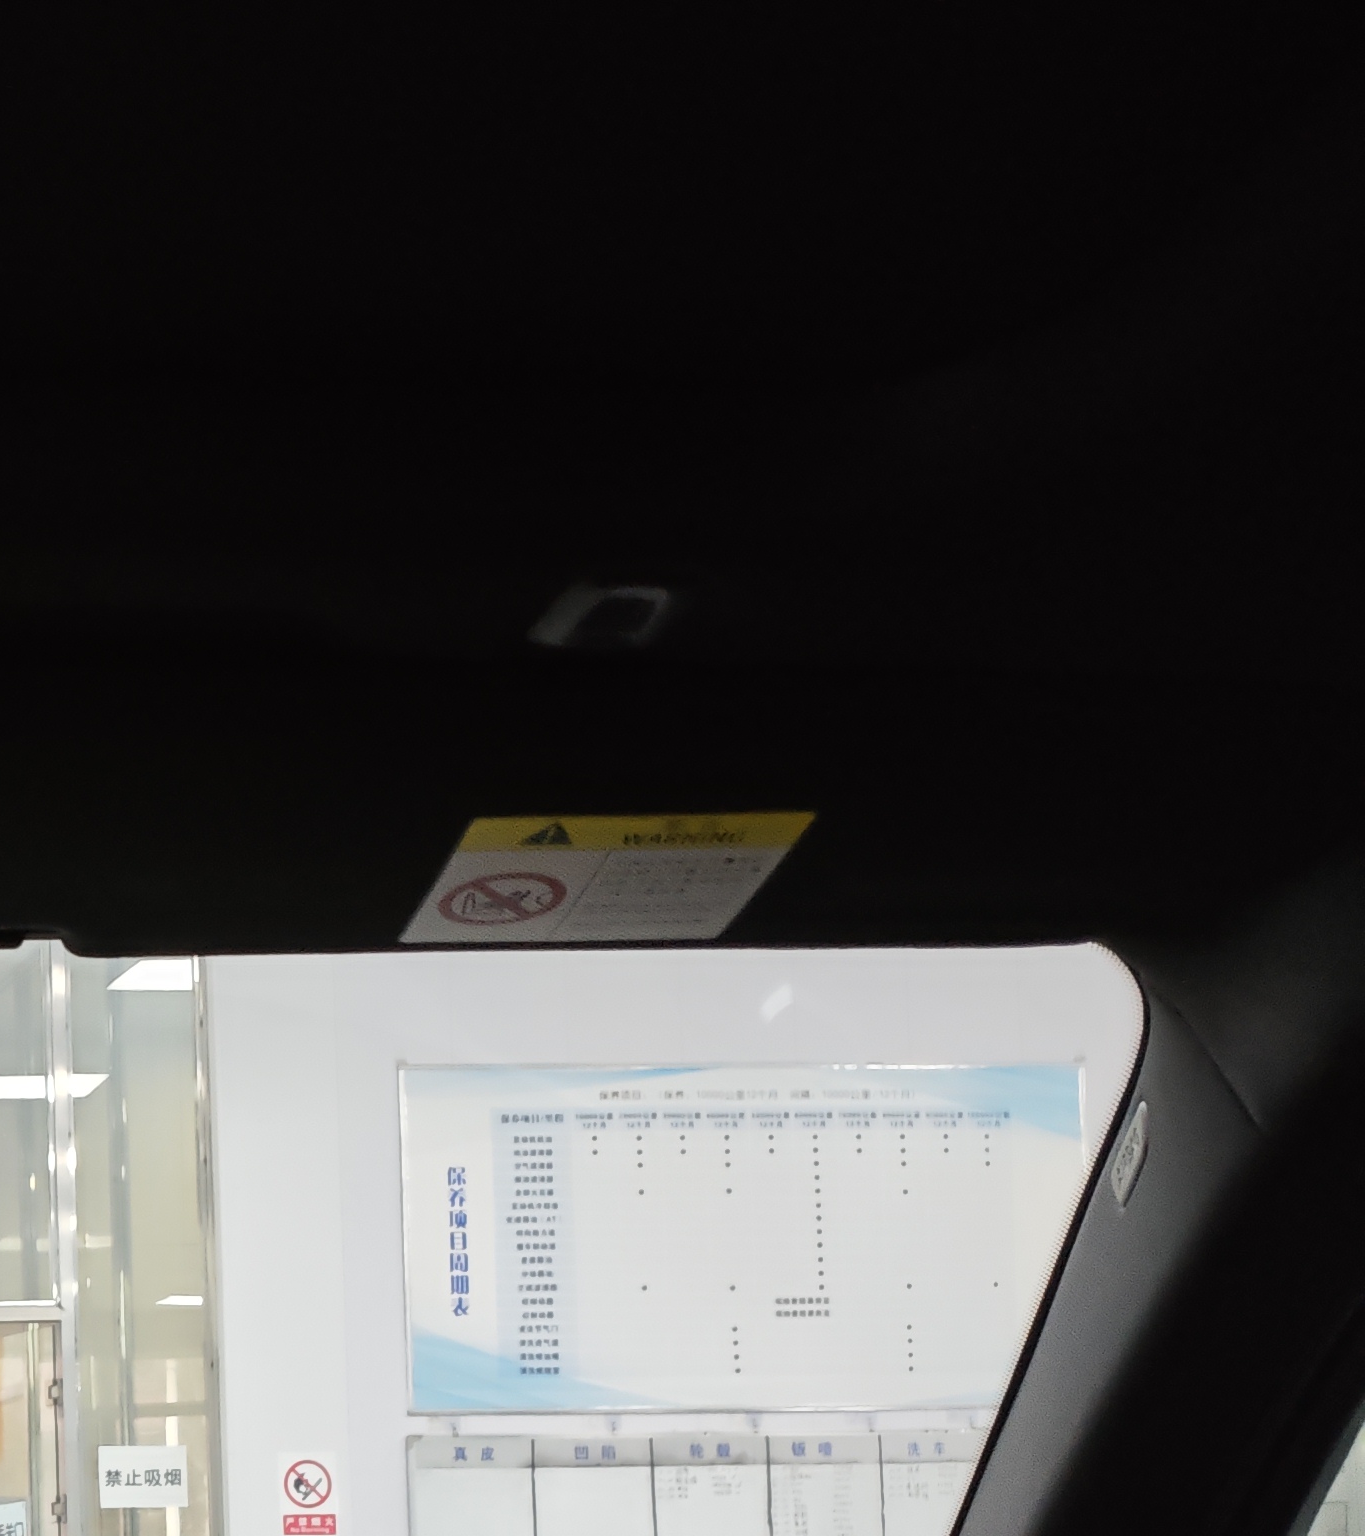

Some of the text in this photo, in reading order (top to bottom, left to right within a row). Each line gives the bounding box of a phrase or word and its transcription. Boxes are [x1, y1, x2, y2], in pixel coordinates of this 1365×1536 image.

[447, 1166, 470, 1317] 保养项目周期表
[105, 1468, 182, 1487] 禁止吸烟
